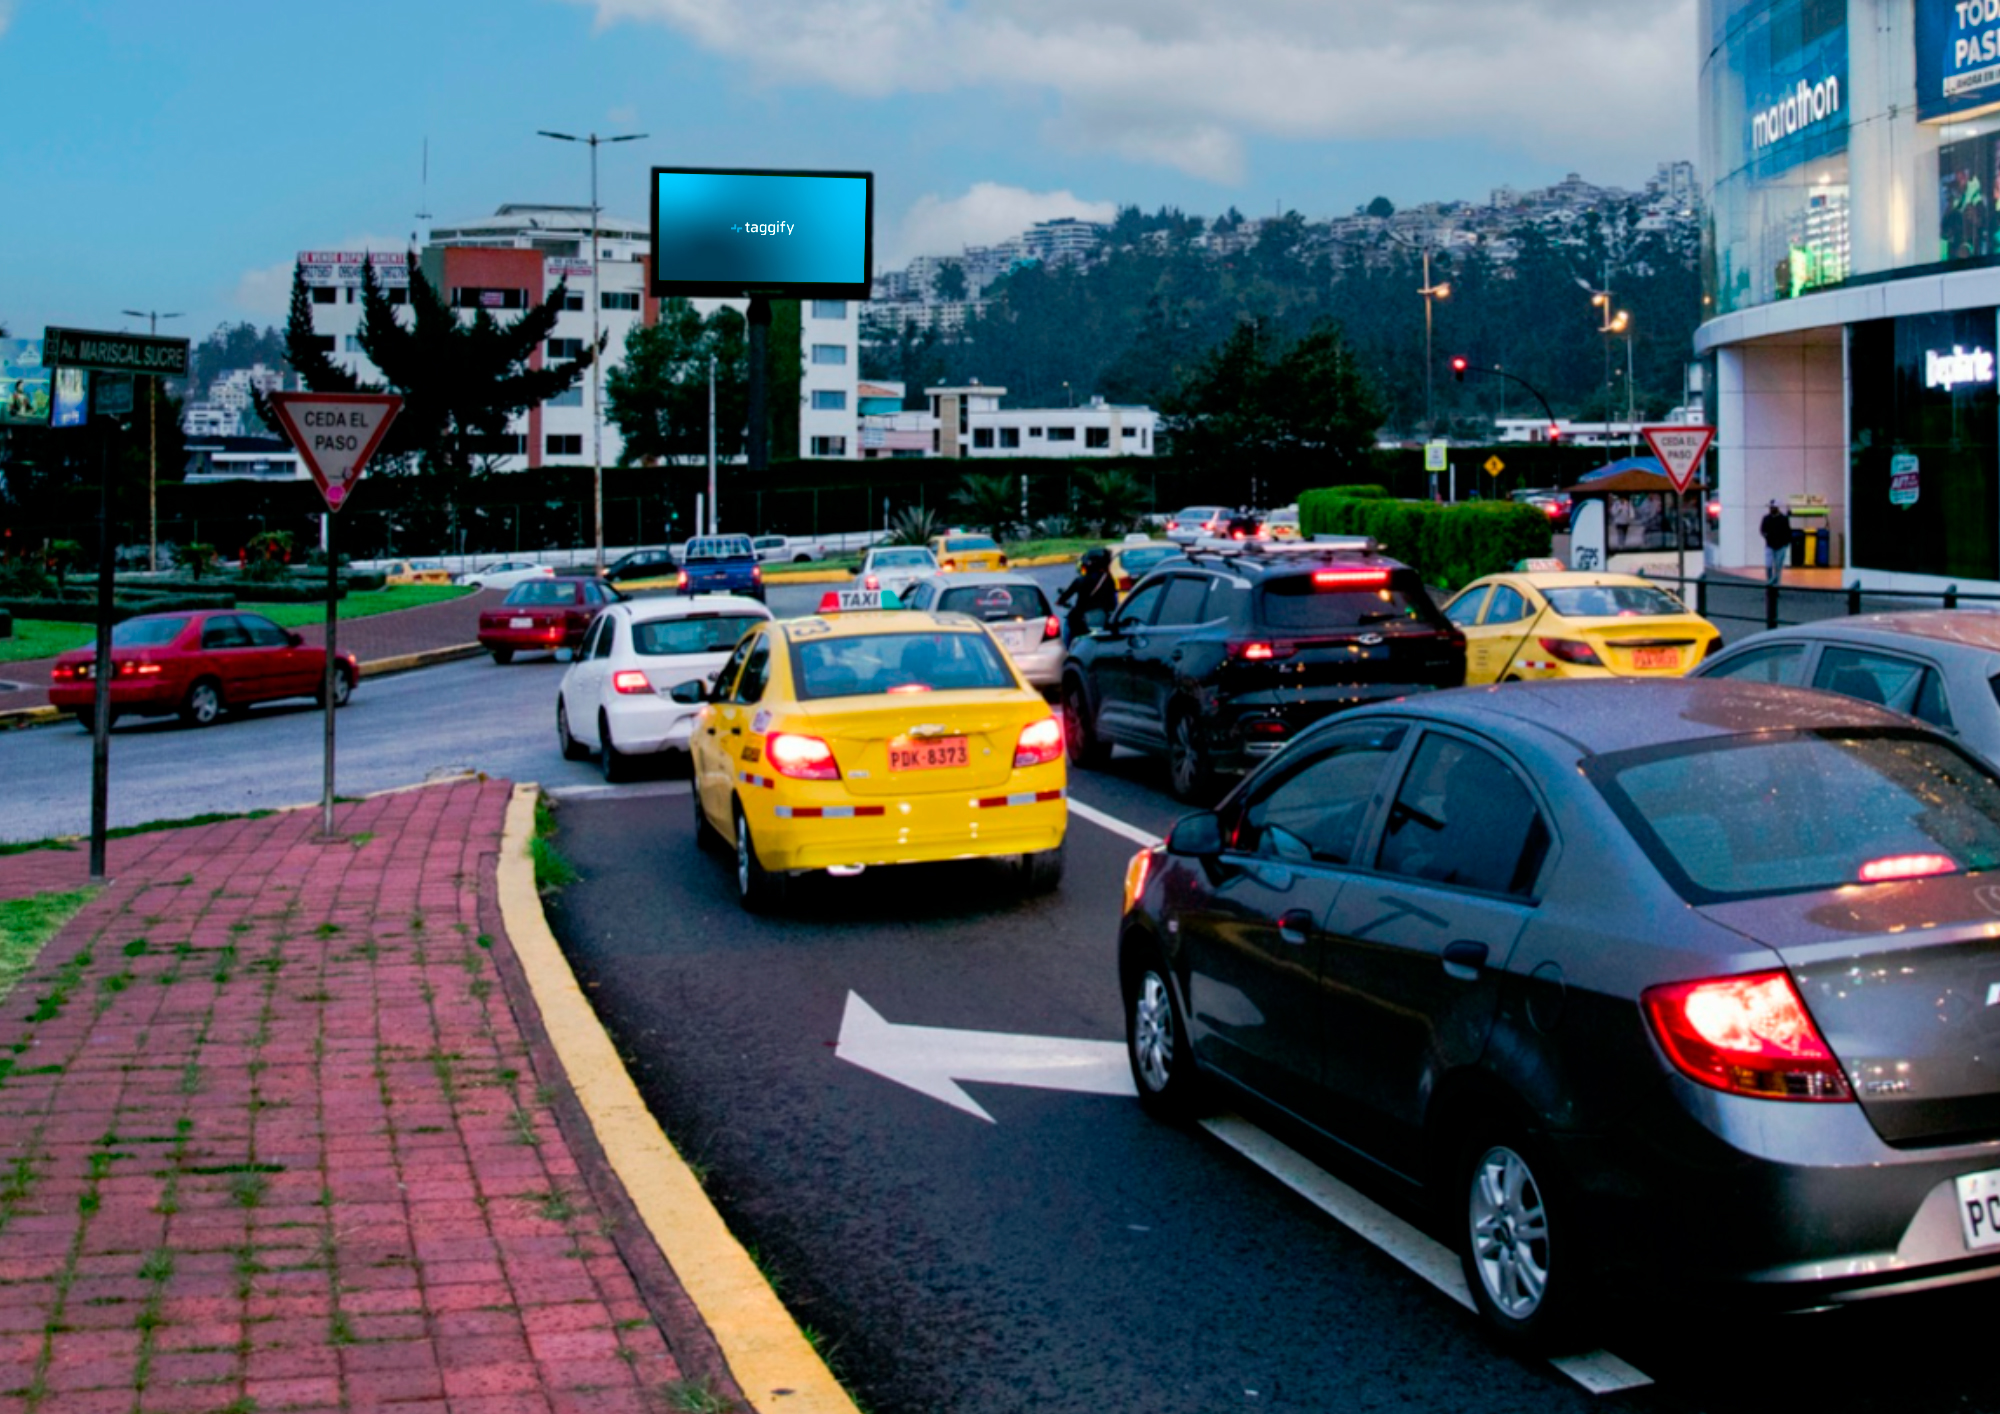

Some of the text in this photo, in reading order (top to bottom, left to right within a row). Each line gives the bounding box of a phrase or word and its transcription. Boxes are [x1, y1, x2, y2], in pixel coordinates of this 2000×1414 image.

[1955, 0, 2000, 30] TOD
[1955, 27, 2000, 69] PAS
[1753, 75, 1839, 150] marathon
[744, 220, 795, 236] taggify
[60, 339, 77, 360] Av.
[80, 340, 142, 365] MARISCAL
[143, 346, 185, 368] SUCRE
[304, 411, 369, 428] CEDA EL
[315, 435, 358, 452] PASO
[1661, 436, 1698, 447] CEDA EL
[1667, 449, 1692, 460] PASO
[841, 591, 879, 607] TAXI
[890, 746, 967, 768] PDK-8373
